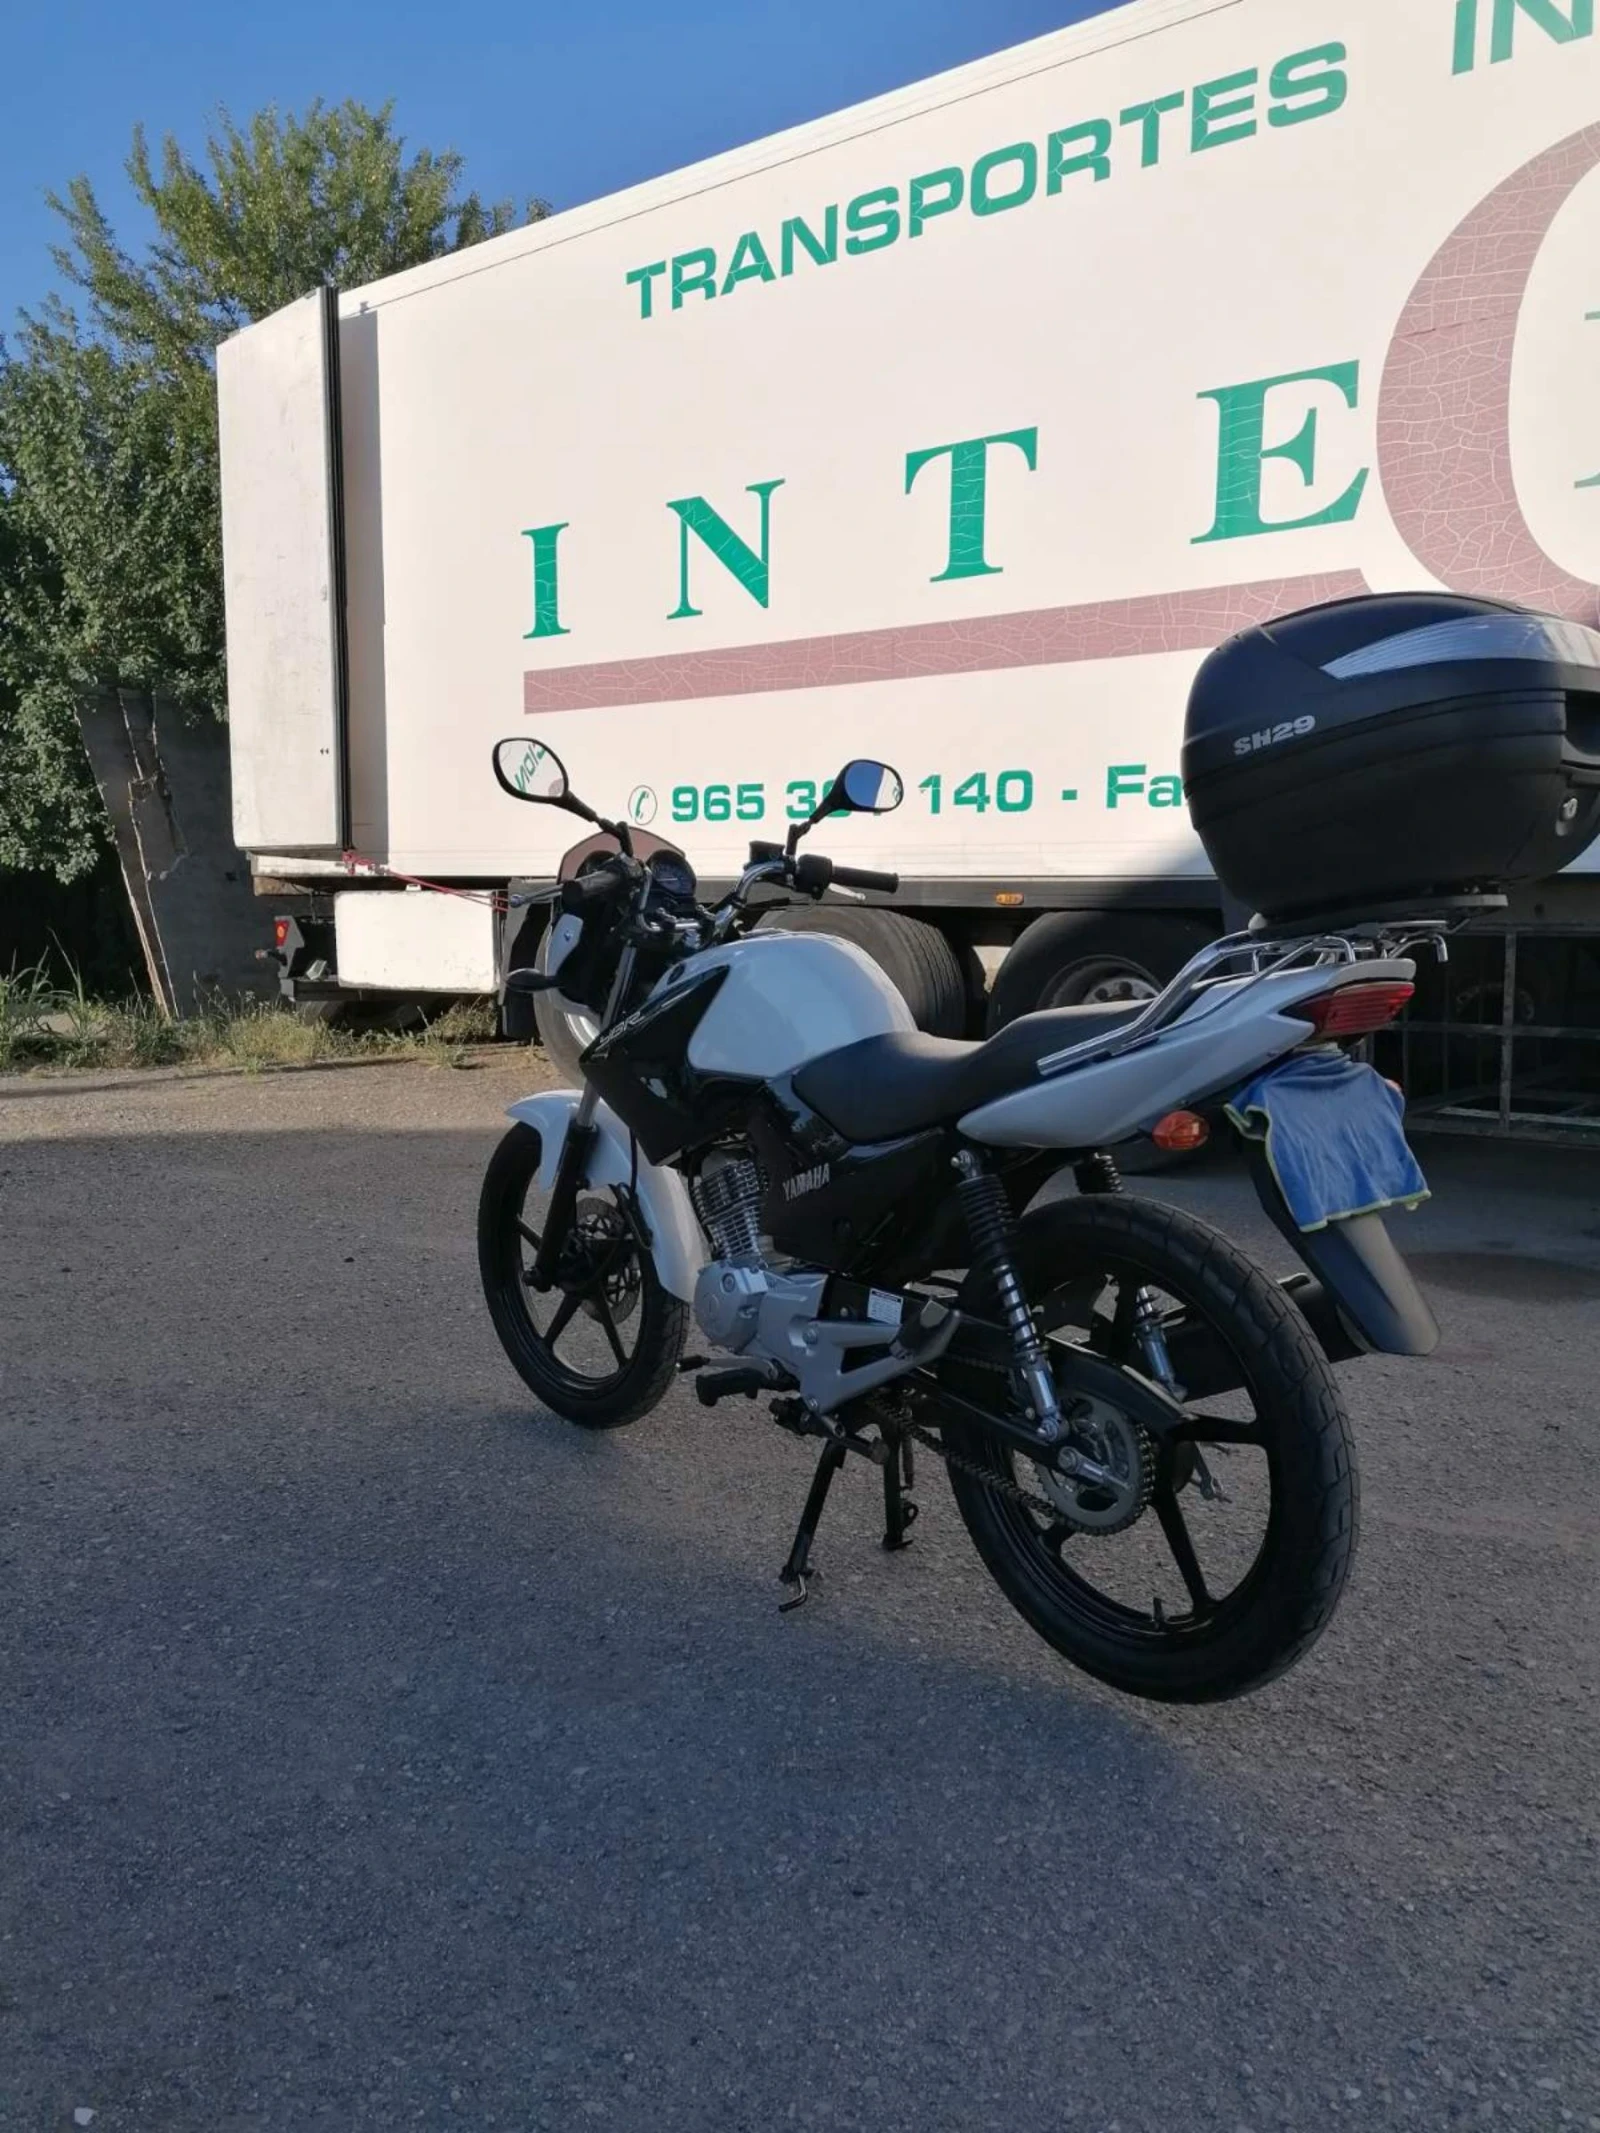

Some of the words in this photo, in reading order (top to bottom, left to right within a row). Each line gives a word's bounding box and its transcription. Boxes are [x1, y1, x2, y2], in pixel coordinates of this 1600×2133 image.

[625, 42, 1345, 318] TRANSPORTES
[1452, 0, 1593, 75] IN
[521, 311, 1600, 639] INTE
[1233, 715, 1316, 756] SH29
[671, 783, 765, 823] 965
[921, 769, 1034, 815] 140
[1106, 764, 1188, 809] Fa
[782, 1162, 830, 1201] YAMAHA
